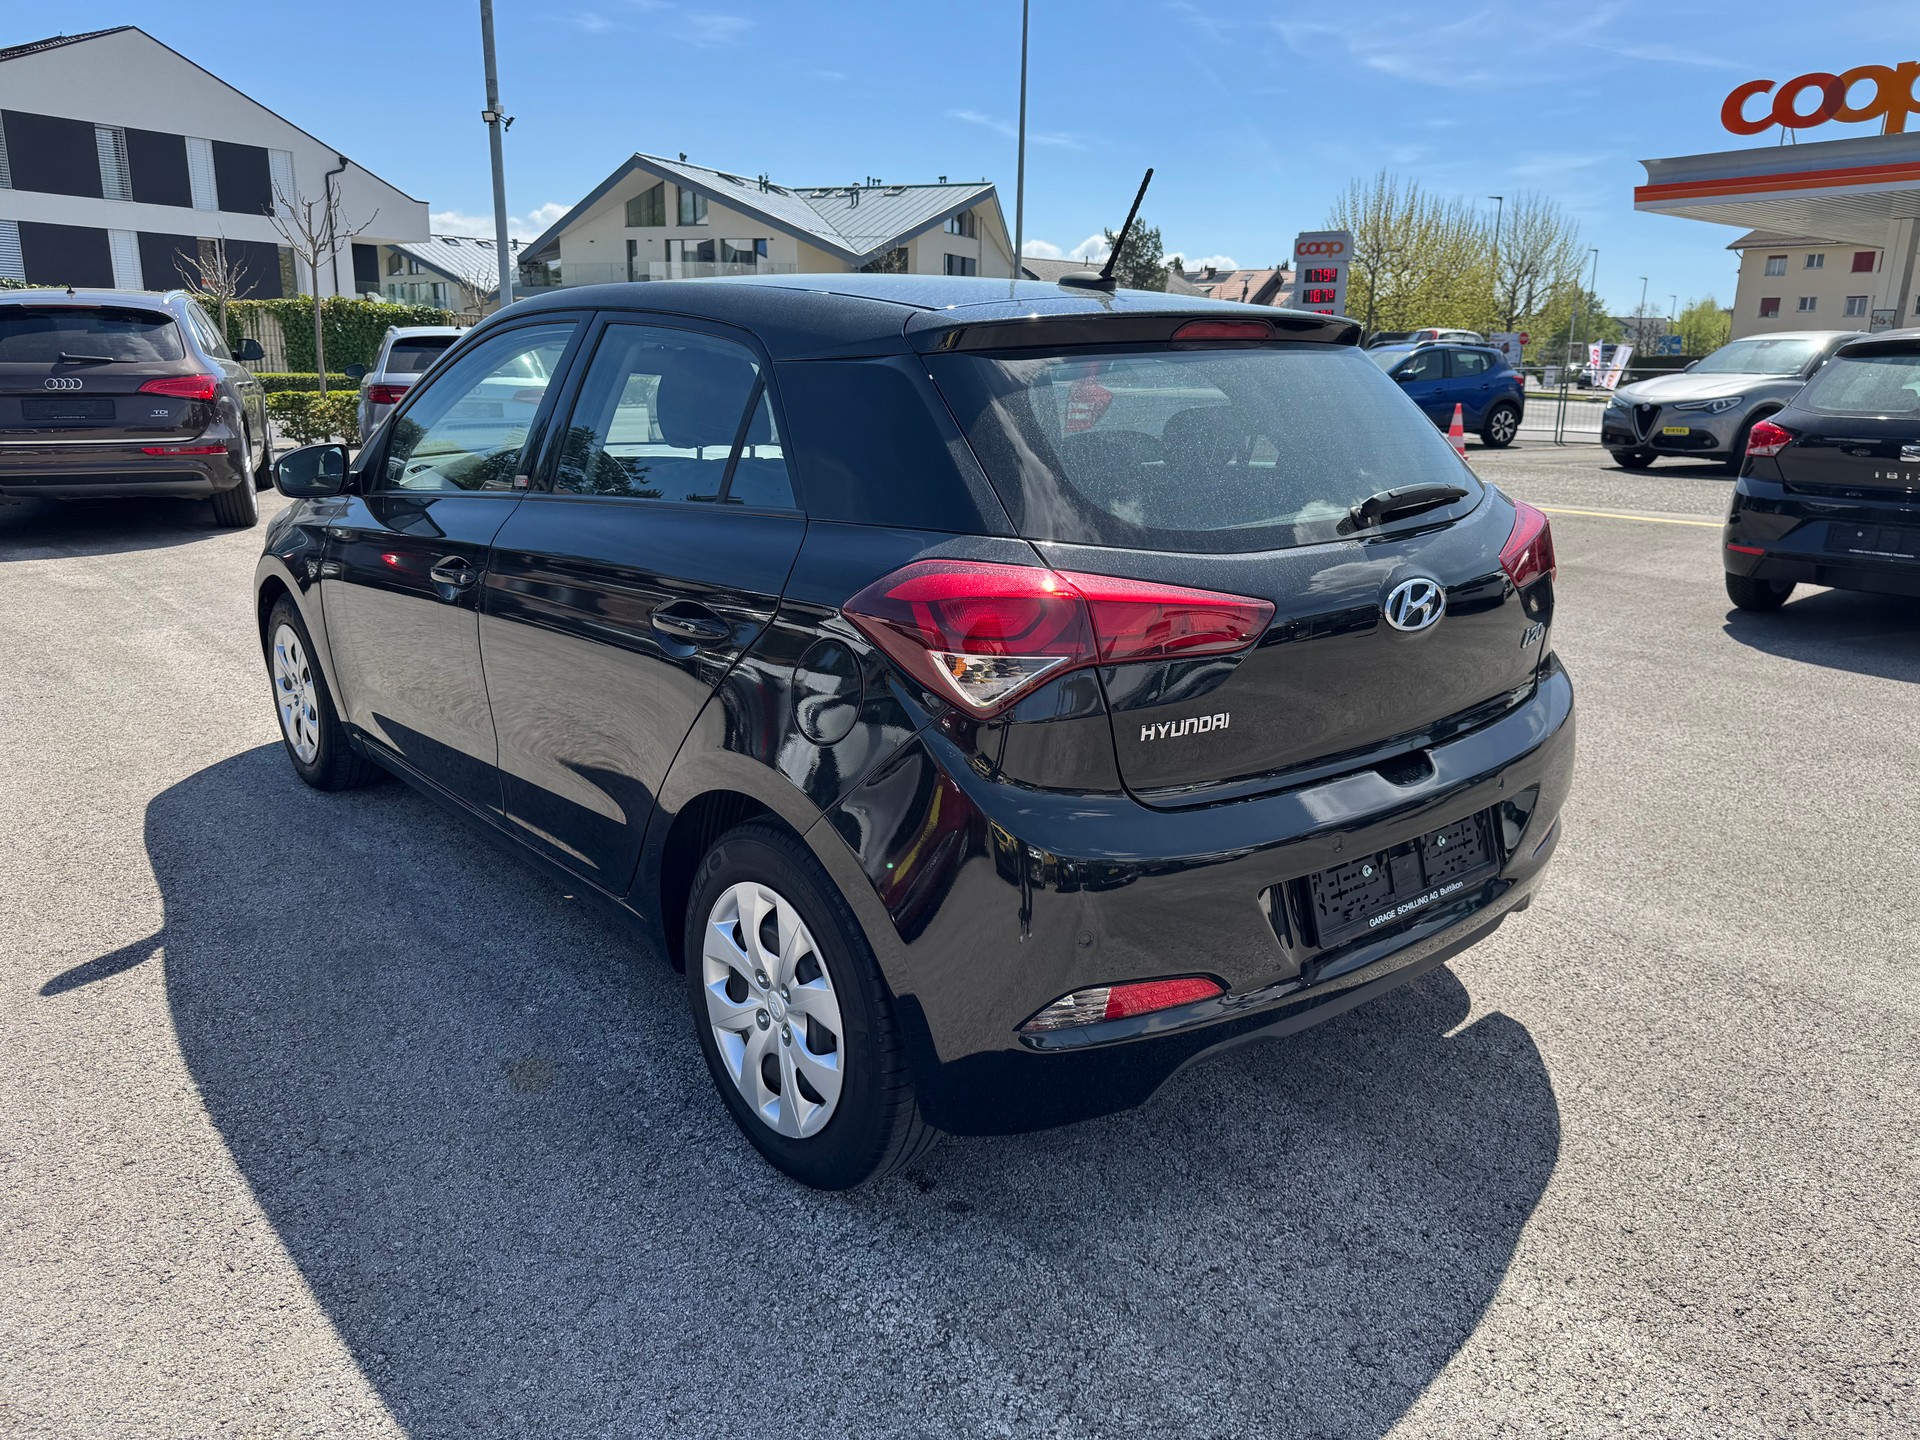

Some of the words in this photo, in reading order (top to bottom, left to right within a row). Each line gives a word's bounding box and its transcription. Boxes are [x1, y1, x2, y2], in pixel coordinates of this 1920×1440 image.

[1720, 60, 1920, 136] coop
[1296, 241, 1344, 258] coop
[1875, 471, 1920, 480] IBI
[1140, 712, 1230, 742] HYUNDAI
[1369, 909, 1396, 927] GARAGE
[1397, 895, 1429, 915] SCHILLING
[1429, 891, 1439, 900] AG
[1440, 881, 1464, 896] Buttikon
